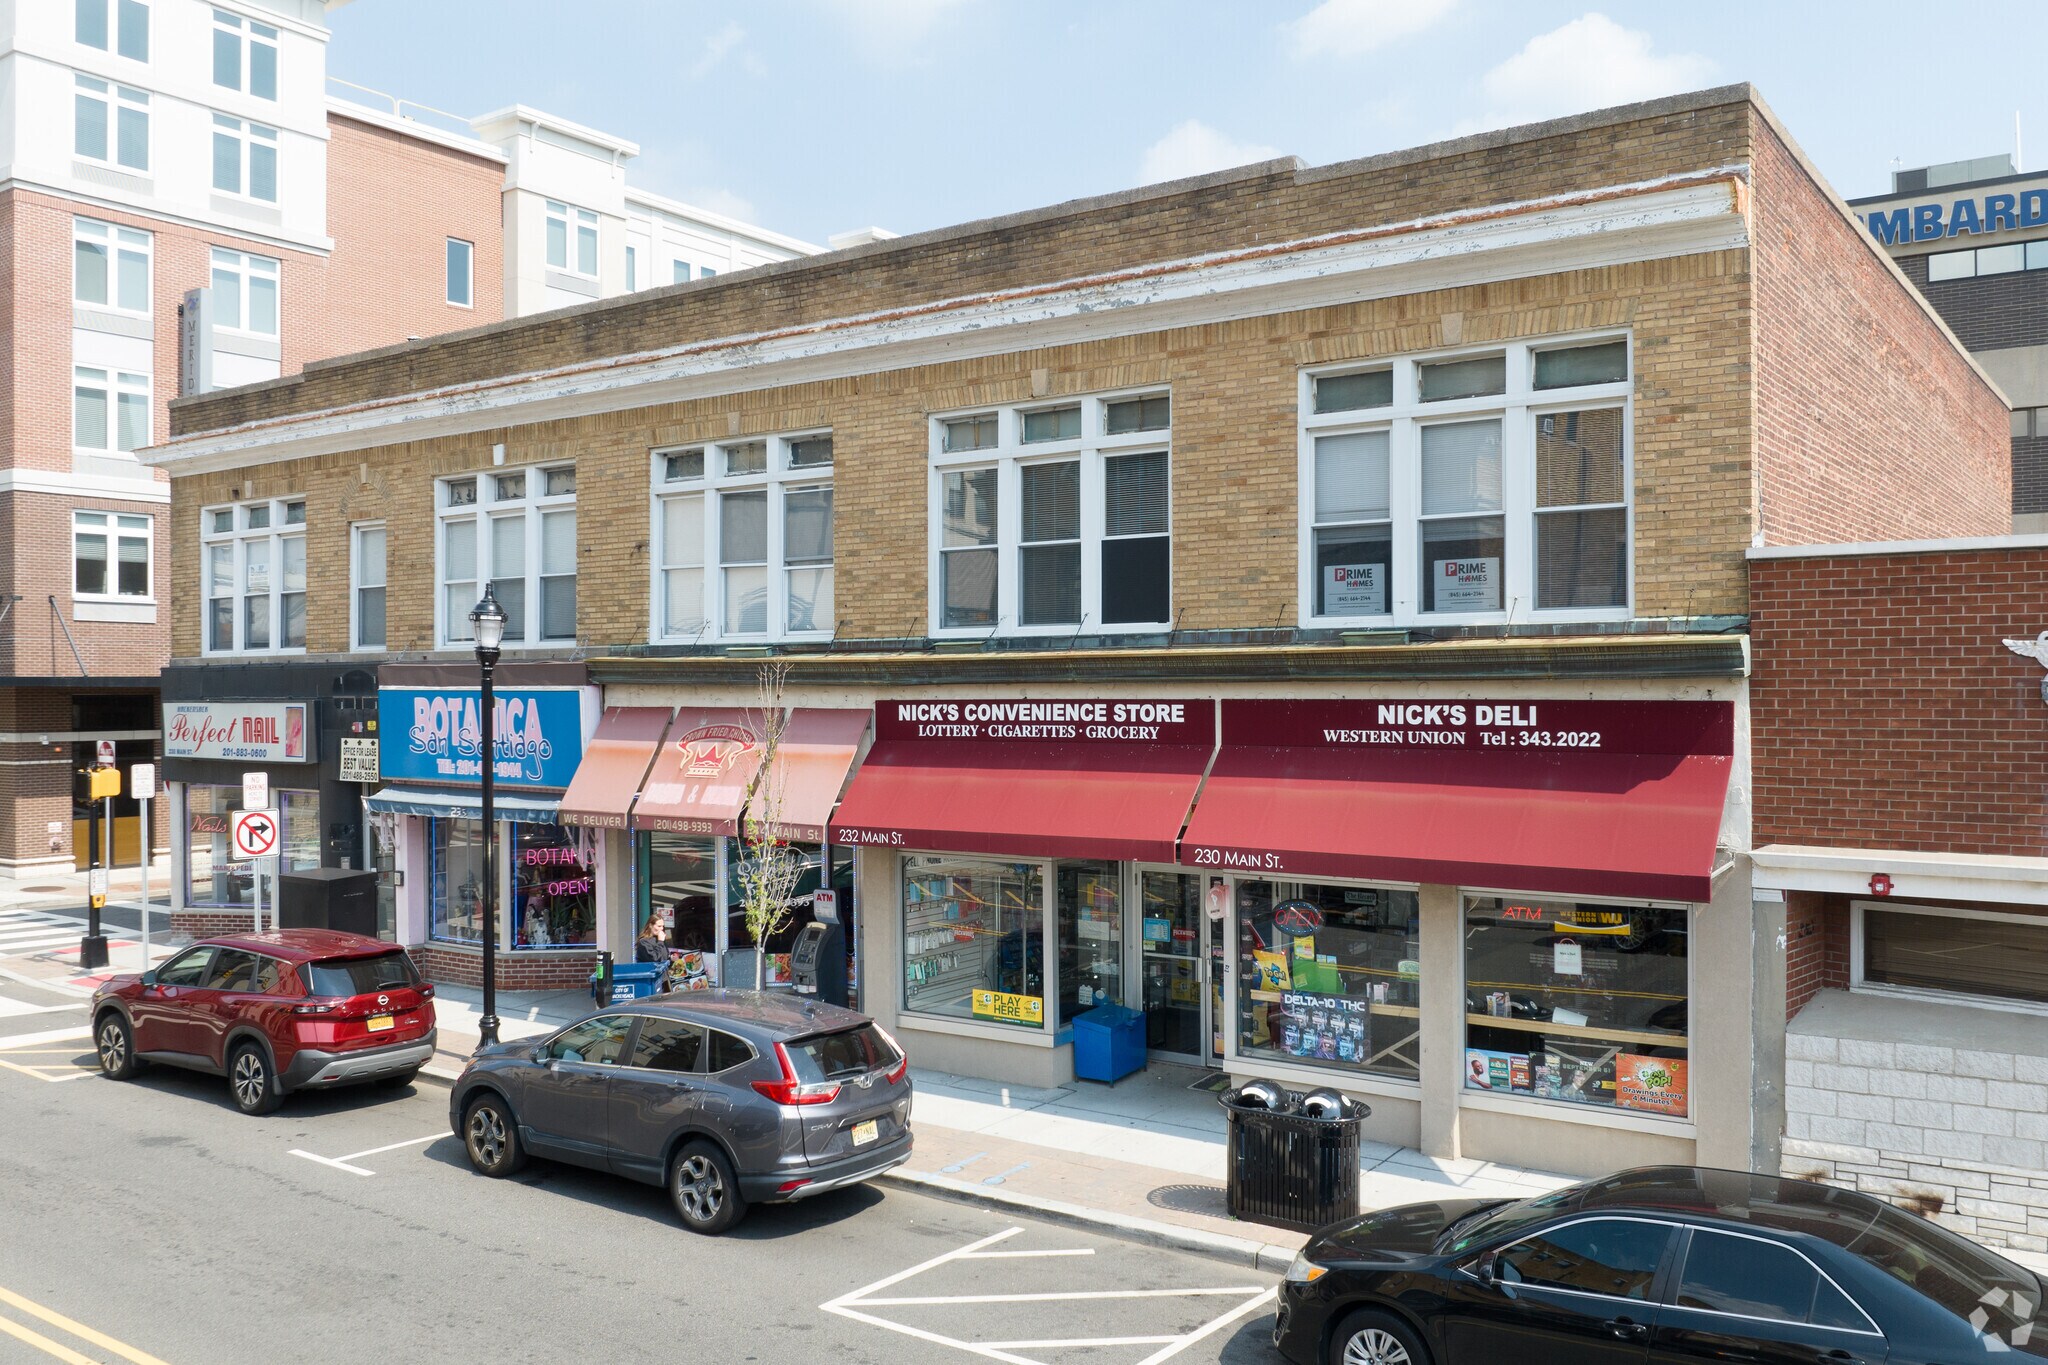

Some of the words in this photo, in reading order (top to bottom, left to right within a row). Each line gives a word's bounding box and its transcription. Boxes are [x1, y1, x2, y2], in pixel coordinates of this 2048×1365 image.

[1855, 188, 2048, 246] MBARD
[188, 321, 196, 395] MERID
[1334, 568, 1372, 582] PRIME
[1445, 562, 1486, 582] PRIME
[898, 704, 959, 721] NICK'S
[965, 704, 1107, 722] CONVENIENCE
[1113, 704, 1184, 723] STORE
[1378, 704, 1467, 726] NICK'S
[1476, 705, 1537, 726] DELI
[169, 714, 237, 753] Perfect
[242, 717, 280, 744] NAIL
[685, 729, 708, 740] CROWN
[707, 727, 729, 738] FRIED
[918, 724, 979, 737] LOTTERY
[988, 725, 1076, 739] CIGARETTES
[1086, 725, 1159, 740] GROCERY
[1323, 729, 1403, 744] WESTERN
[1408, 730, 1466, 745] UNION
[1519, 731, 1601, 747] 343.2022
[409, 726, 448, 757] San
[222, 748, 267, 758] 201-883-0600
[343, 747, 356, 756] OFFICE
[364, 747, 377, 757] LEASE
[343, 758, 356, 770] BEST
[358, 758, 376, 771] VALUE
[456, 760, 523, 778] 201-4-1944
[191, 815, 227, 833] Nails
[563, 814, 578, 824] WE
[583, 816, 621, 827] DELIVER
[653, 820, 713, 833] (201)498-9393
[807, 829, 821, 841] St.
[839, 829, 859, 843] 232
[861, 830, 888, 844] MAIN
[889, 831, 905, 845] ST.
[1195, 848, 1221, 864] 230
[1224, 851, 1260, 867] MAIN
[1265, 853, 1284, 869] ST.
[548, 880, 588, 896] OPEN
[816, 894, 833, 902] ATM
[1275, 909, 1322, 927] OPEN
[1502, 906, 1542, 920] ATM
[993, 994, 1021, 1007] PLAY
[1284, 993, 1336, 1009] DELTA-10
[1340, 999, 1366, 1012] THC
[993, 1004, 1021, 1018] HERE
[1645, 1075, 1673, 1089] POP!
[1622, 1086, 1658, 1097] Drawings
[1660, 1091, 1683, 1100] Every
[1639, 1095, 1672, 1106] Minutes!
[810, 1122, 833, 1131] CR-V
